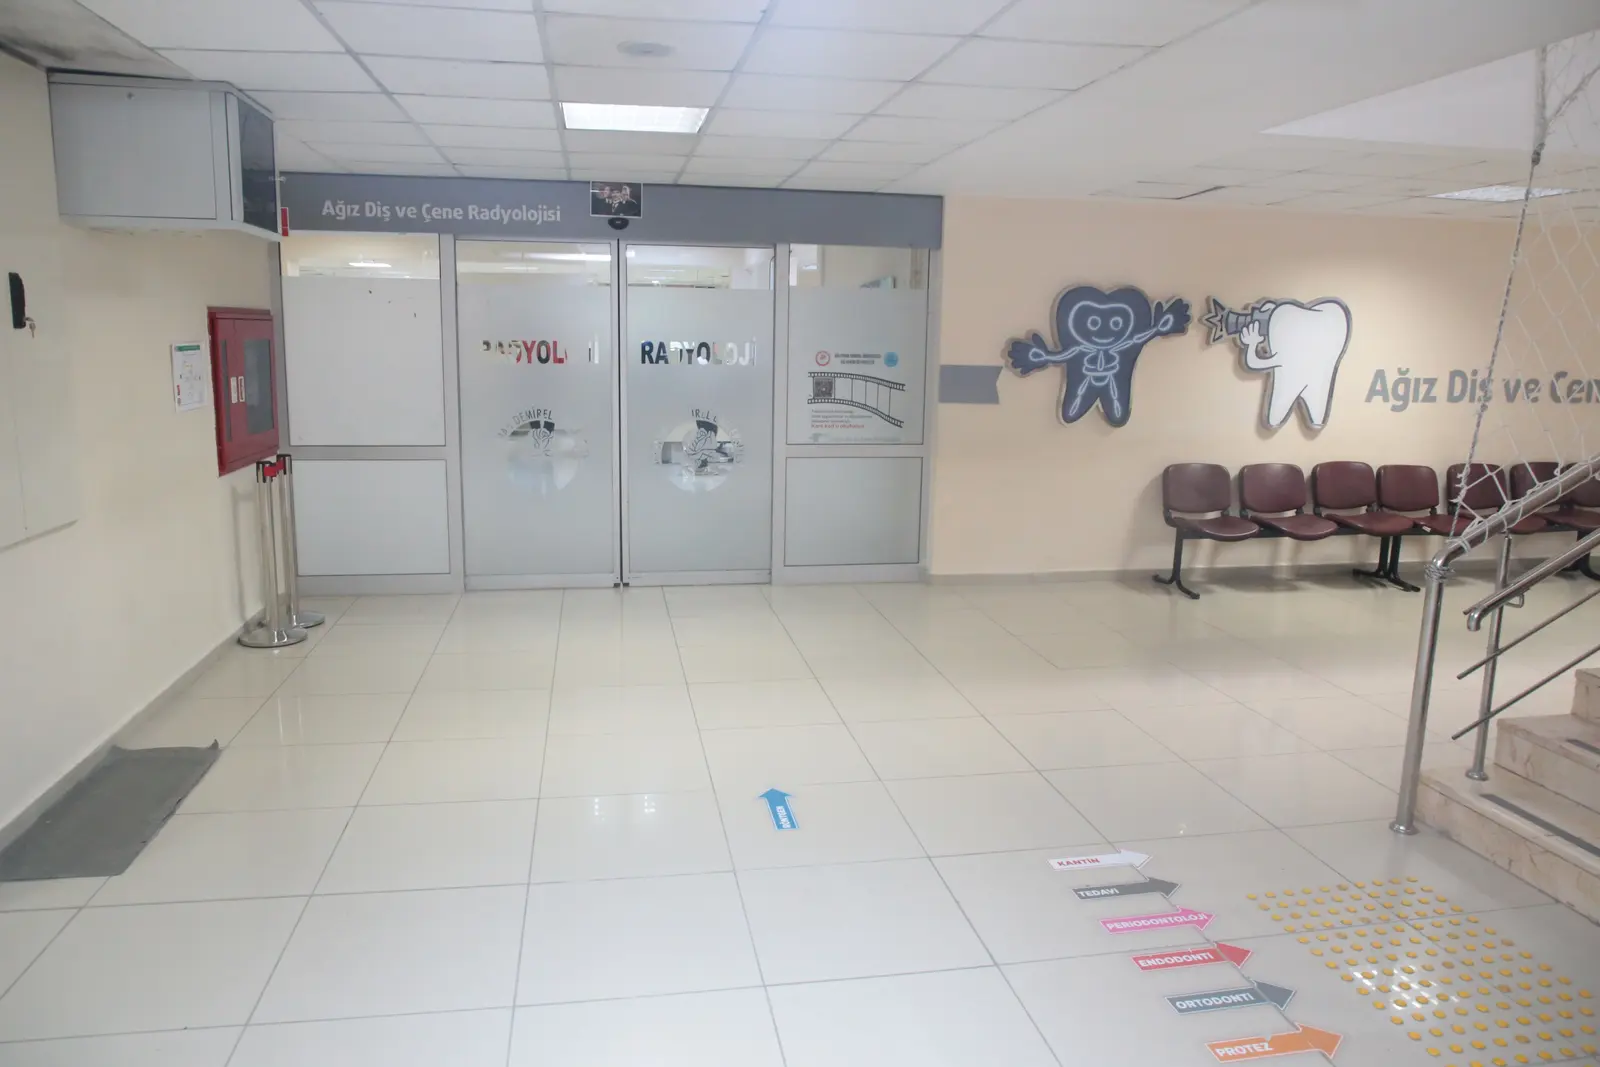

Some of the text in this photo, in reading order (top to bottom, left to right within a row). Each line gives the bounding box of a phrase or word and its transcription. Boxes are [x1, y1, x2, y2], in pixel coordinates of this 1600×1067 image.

[321, 199, 561, 225] Ağız Diş ve Çene Radyolojisi
[1364, 367, 1438, 412] Ağız
[1502, 378, 1541, 404] ve
[1214, 1042, 1274, 1057] PROTEZ
